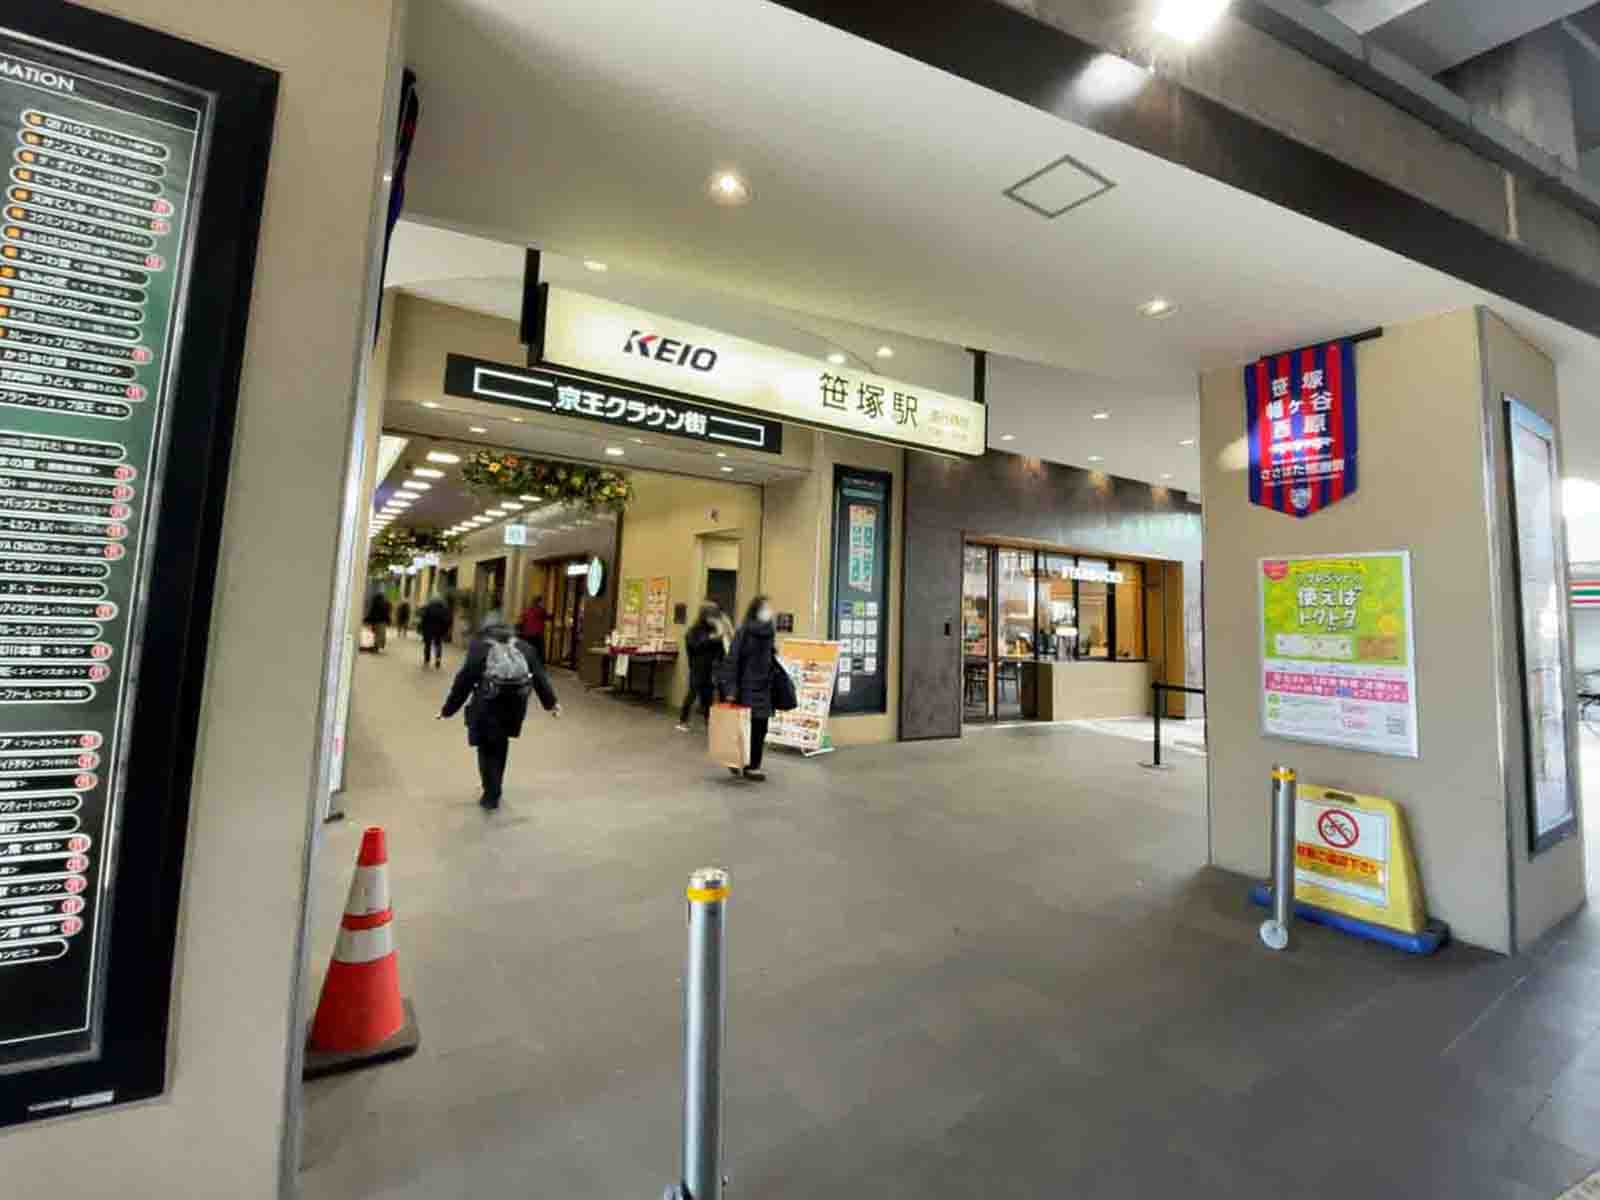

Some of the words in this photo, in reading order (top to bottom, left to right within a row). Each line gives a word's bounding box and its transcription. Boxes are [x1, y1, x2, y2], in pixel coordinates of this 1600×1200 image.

[622, 329, 718, 372] KEIO
[556, 385, 708, 435] 京王クラウン街
[820, 373, 919, 428] 笹塚駅
